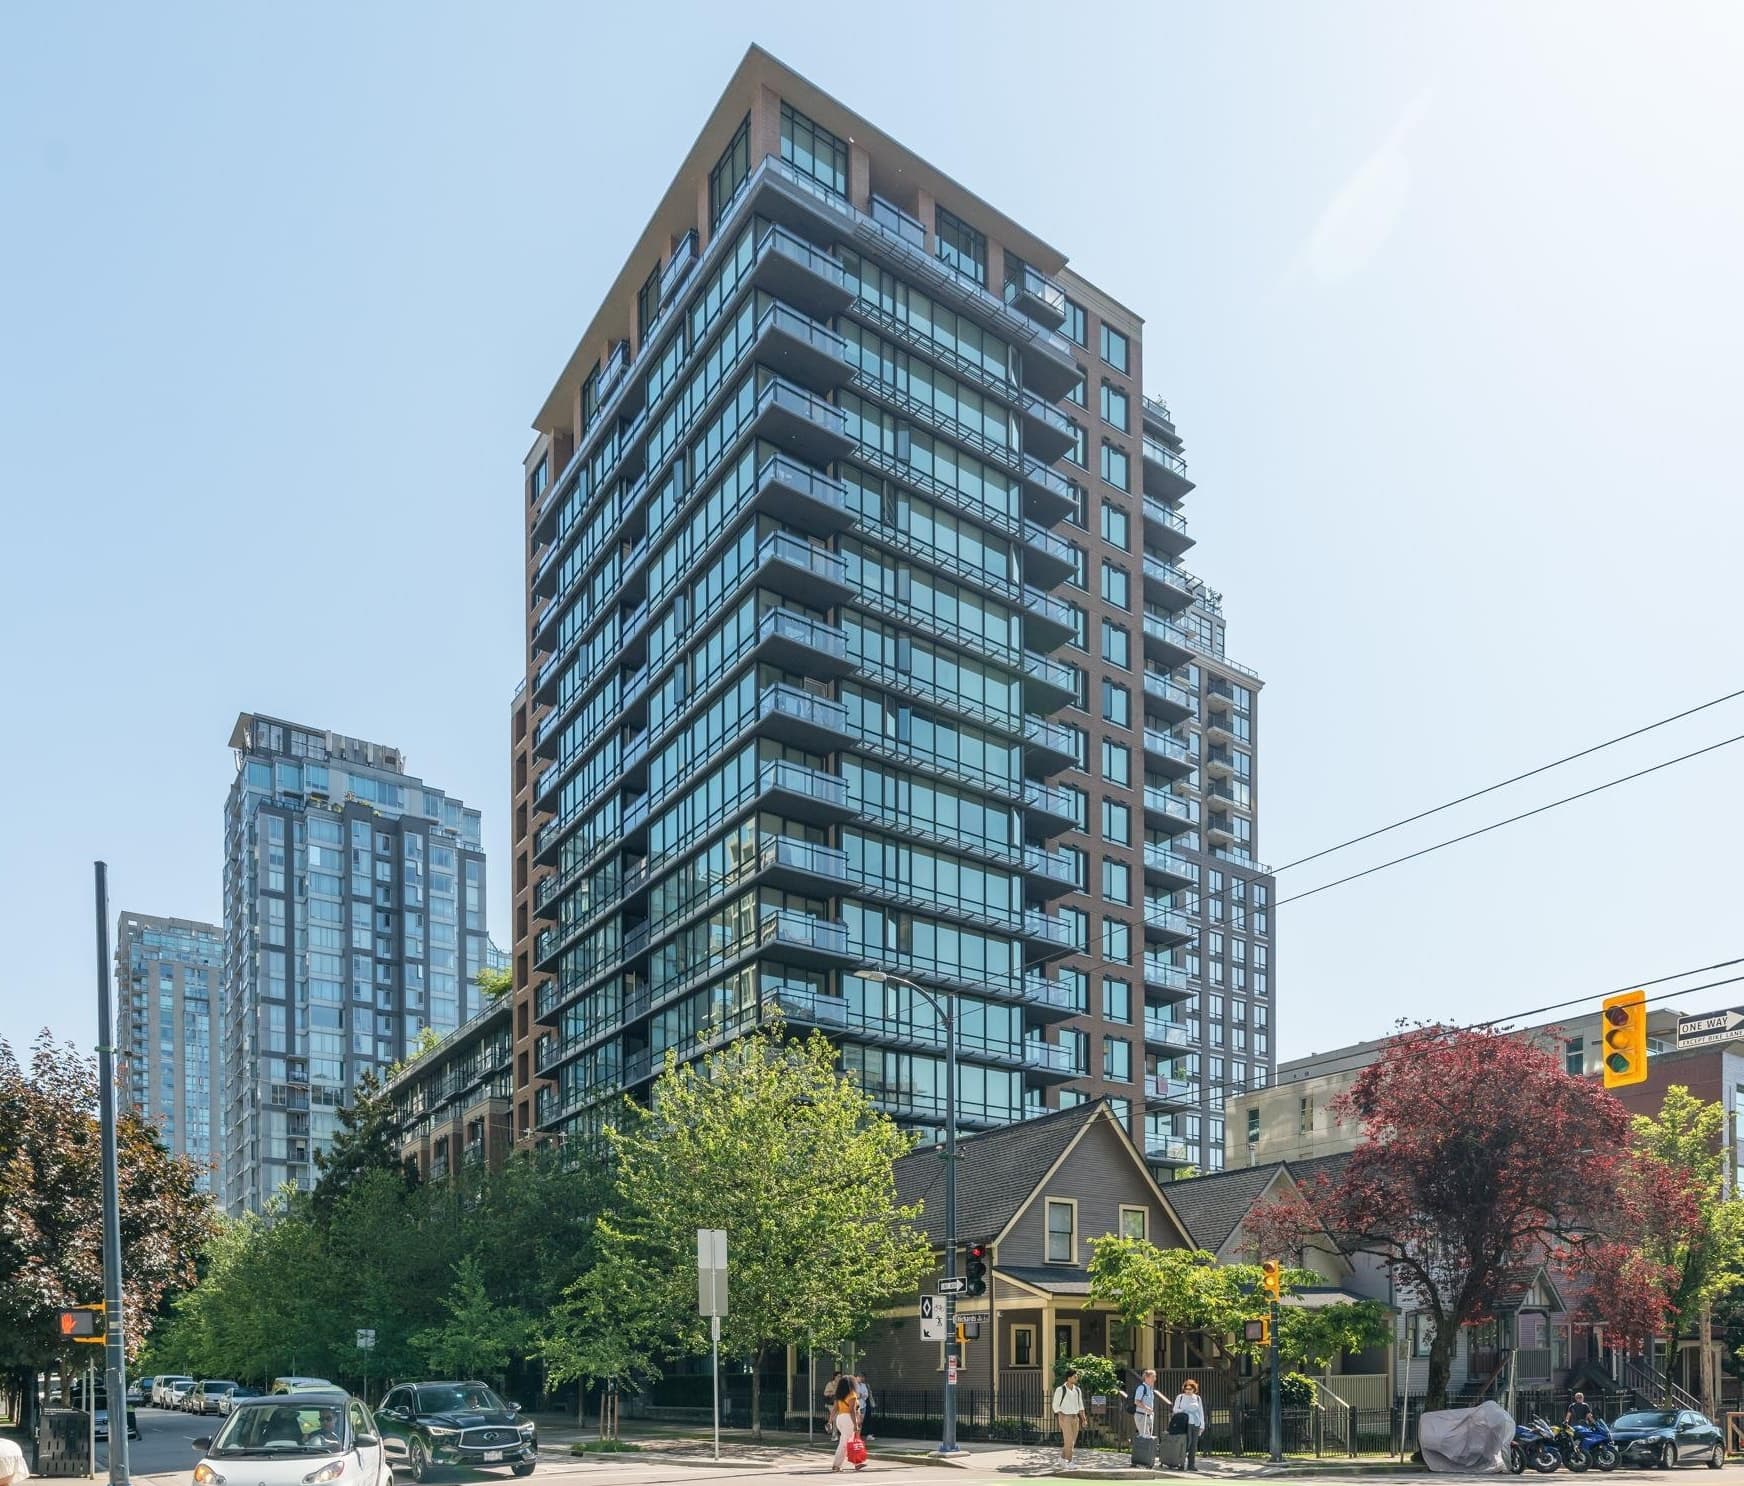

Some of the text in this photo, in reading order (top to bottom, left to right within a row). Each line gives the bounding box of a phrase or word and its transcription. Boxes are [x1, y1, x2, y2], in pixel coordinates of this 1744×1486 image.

[1682, 1017, 1728, 1033] ONE WAY
[1682, 1030, 1743, 1046] EXCEPT BIKE LANE
